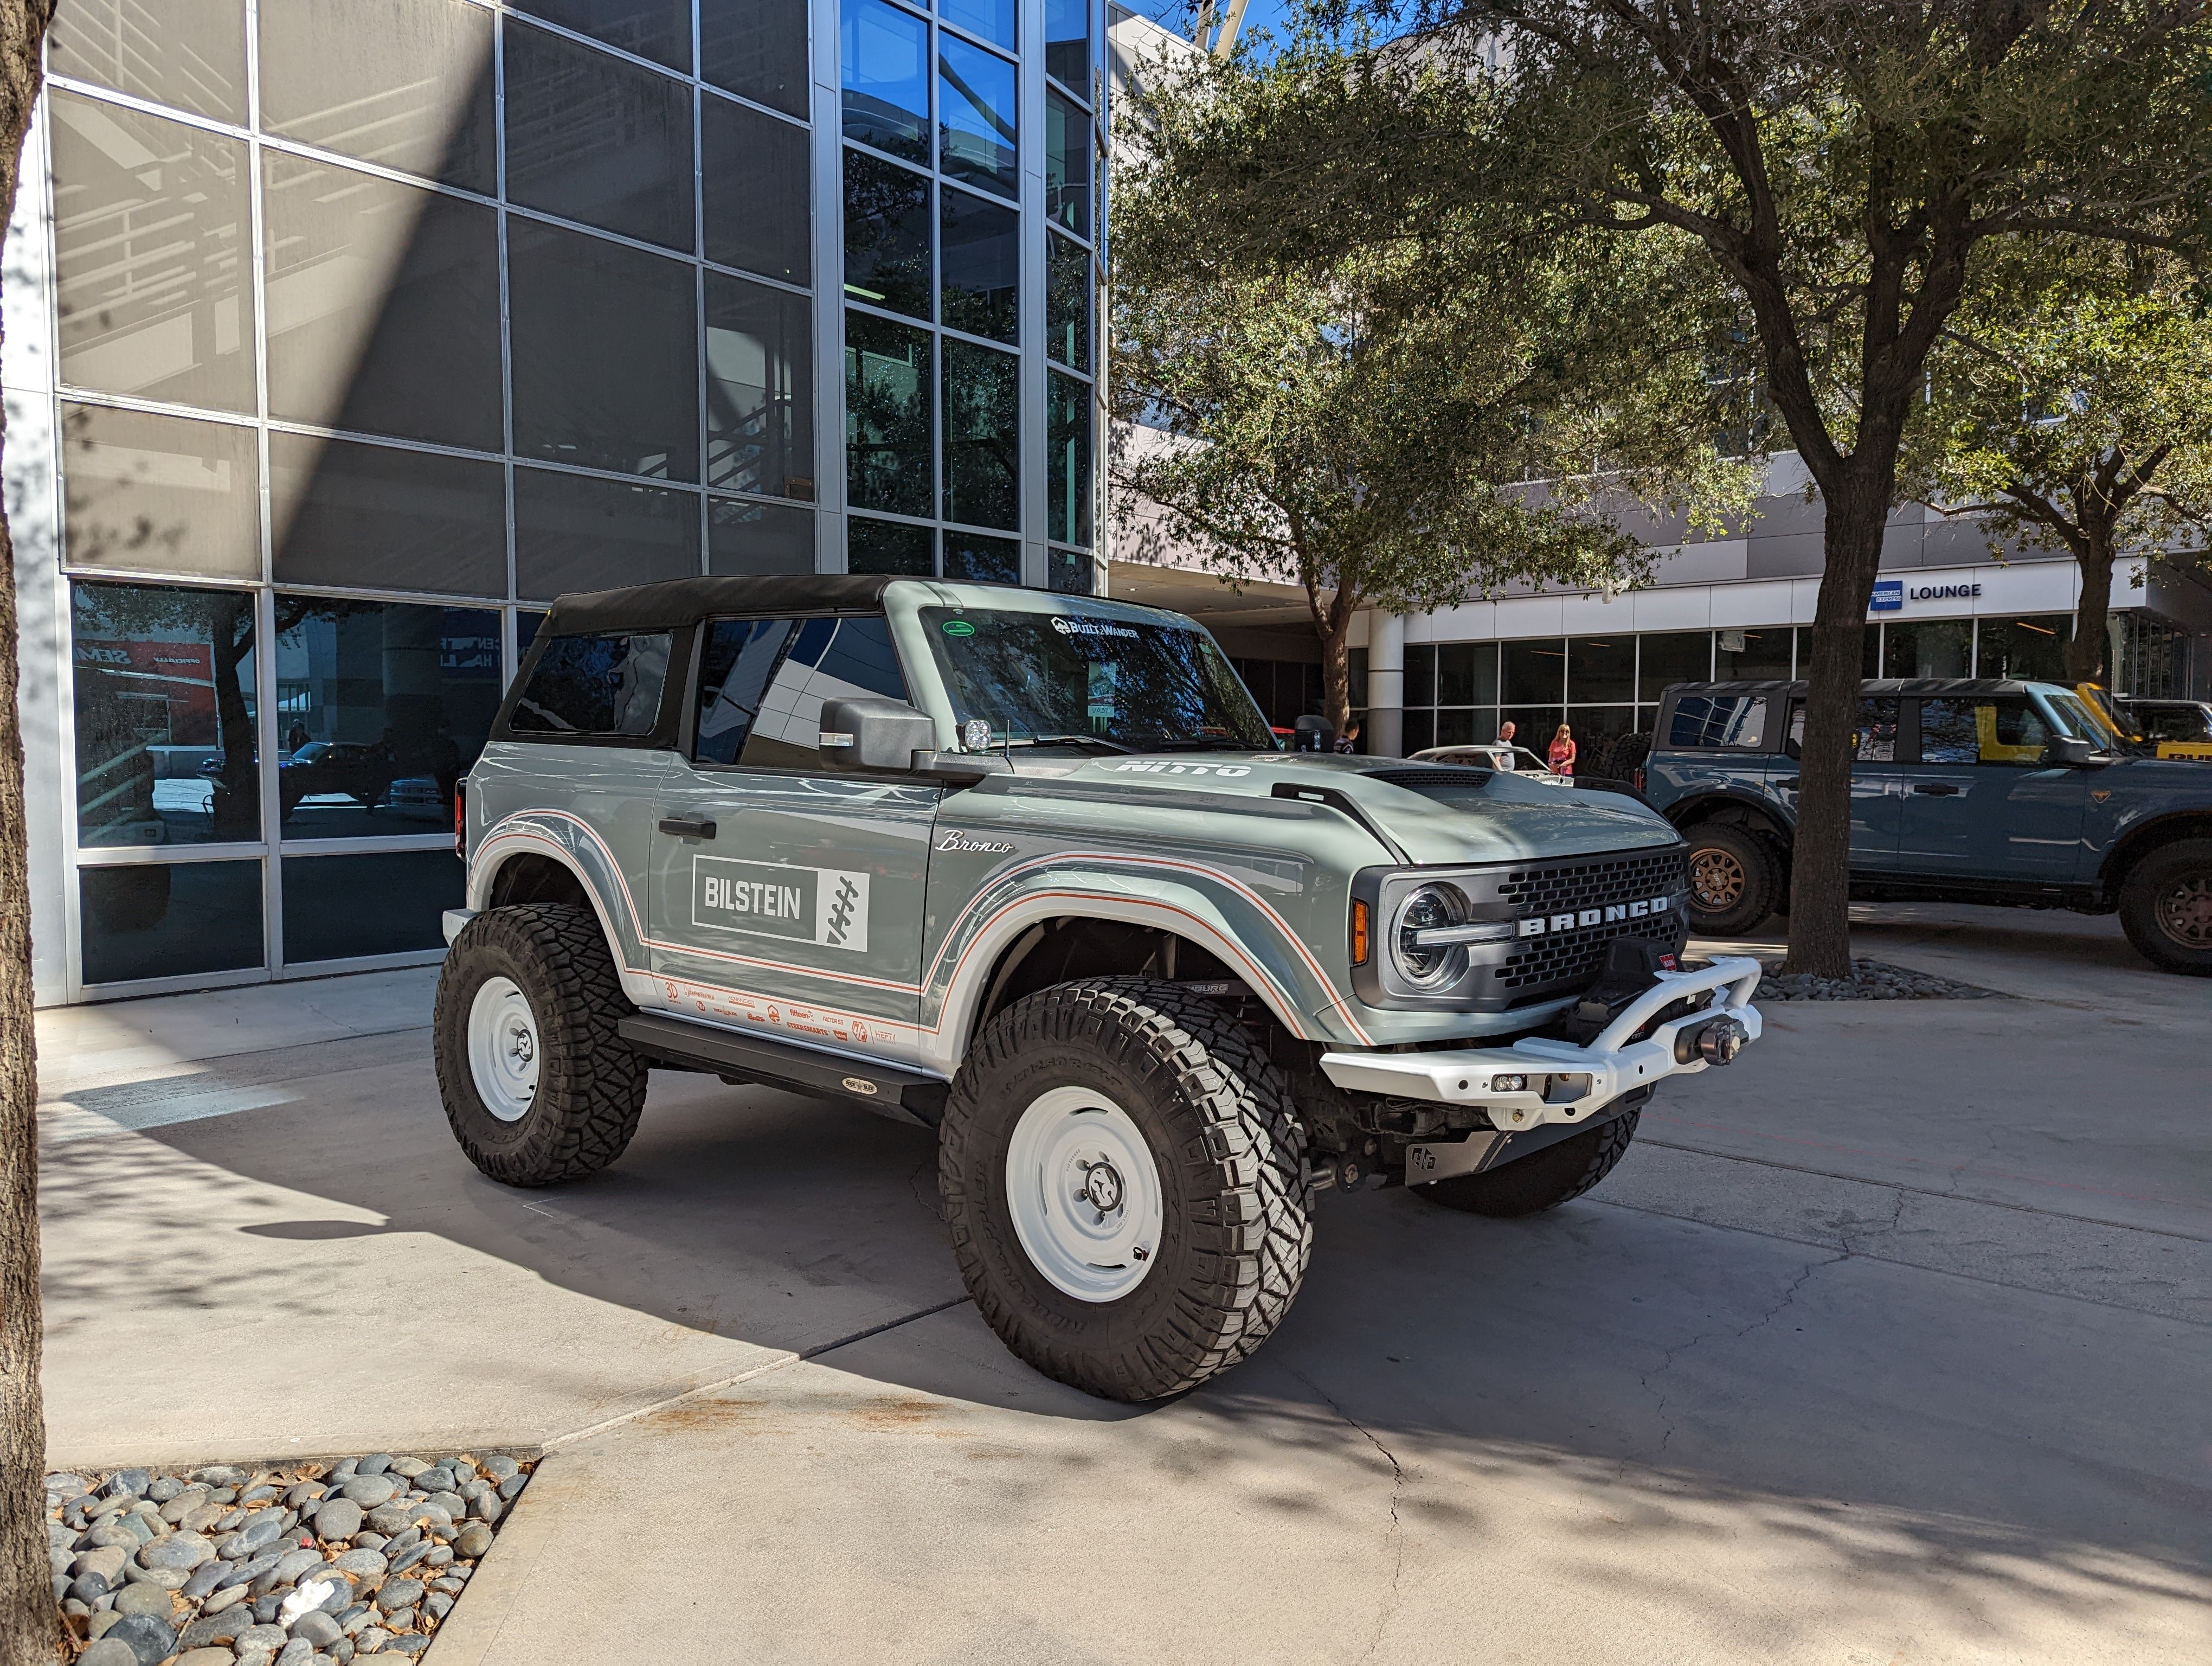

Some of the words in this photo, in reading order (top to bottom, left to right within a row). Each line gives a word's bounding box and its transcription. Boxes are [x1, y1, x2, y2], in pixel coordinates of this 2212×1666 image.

[1910, 584, 1982, 600] LOUNGE
[1115, 760, 1252, 777] NITTO
[935, 830, 1013, 853] Bronco
[705, 876, 801, 919] BILSTEIN
[1519, 896, 1668, 938] BRONCO
[822, 1016, 837, 1024] FACTOR
[786, 1022, 829, 1036] STEERSMARTS
